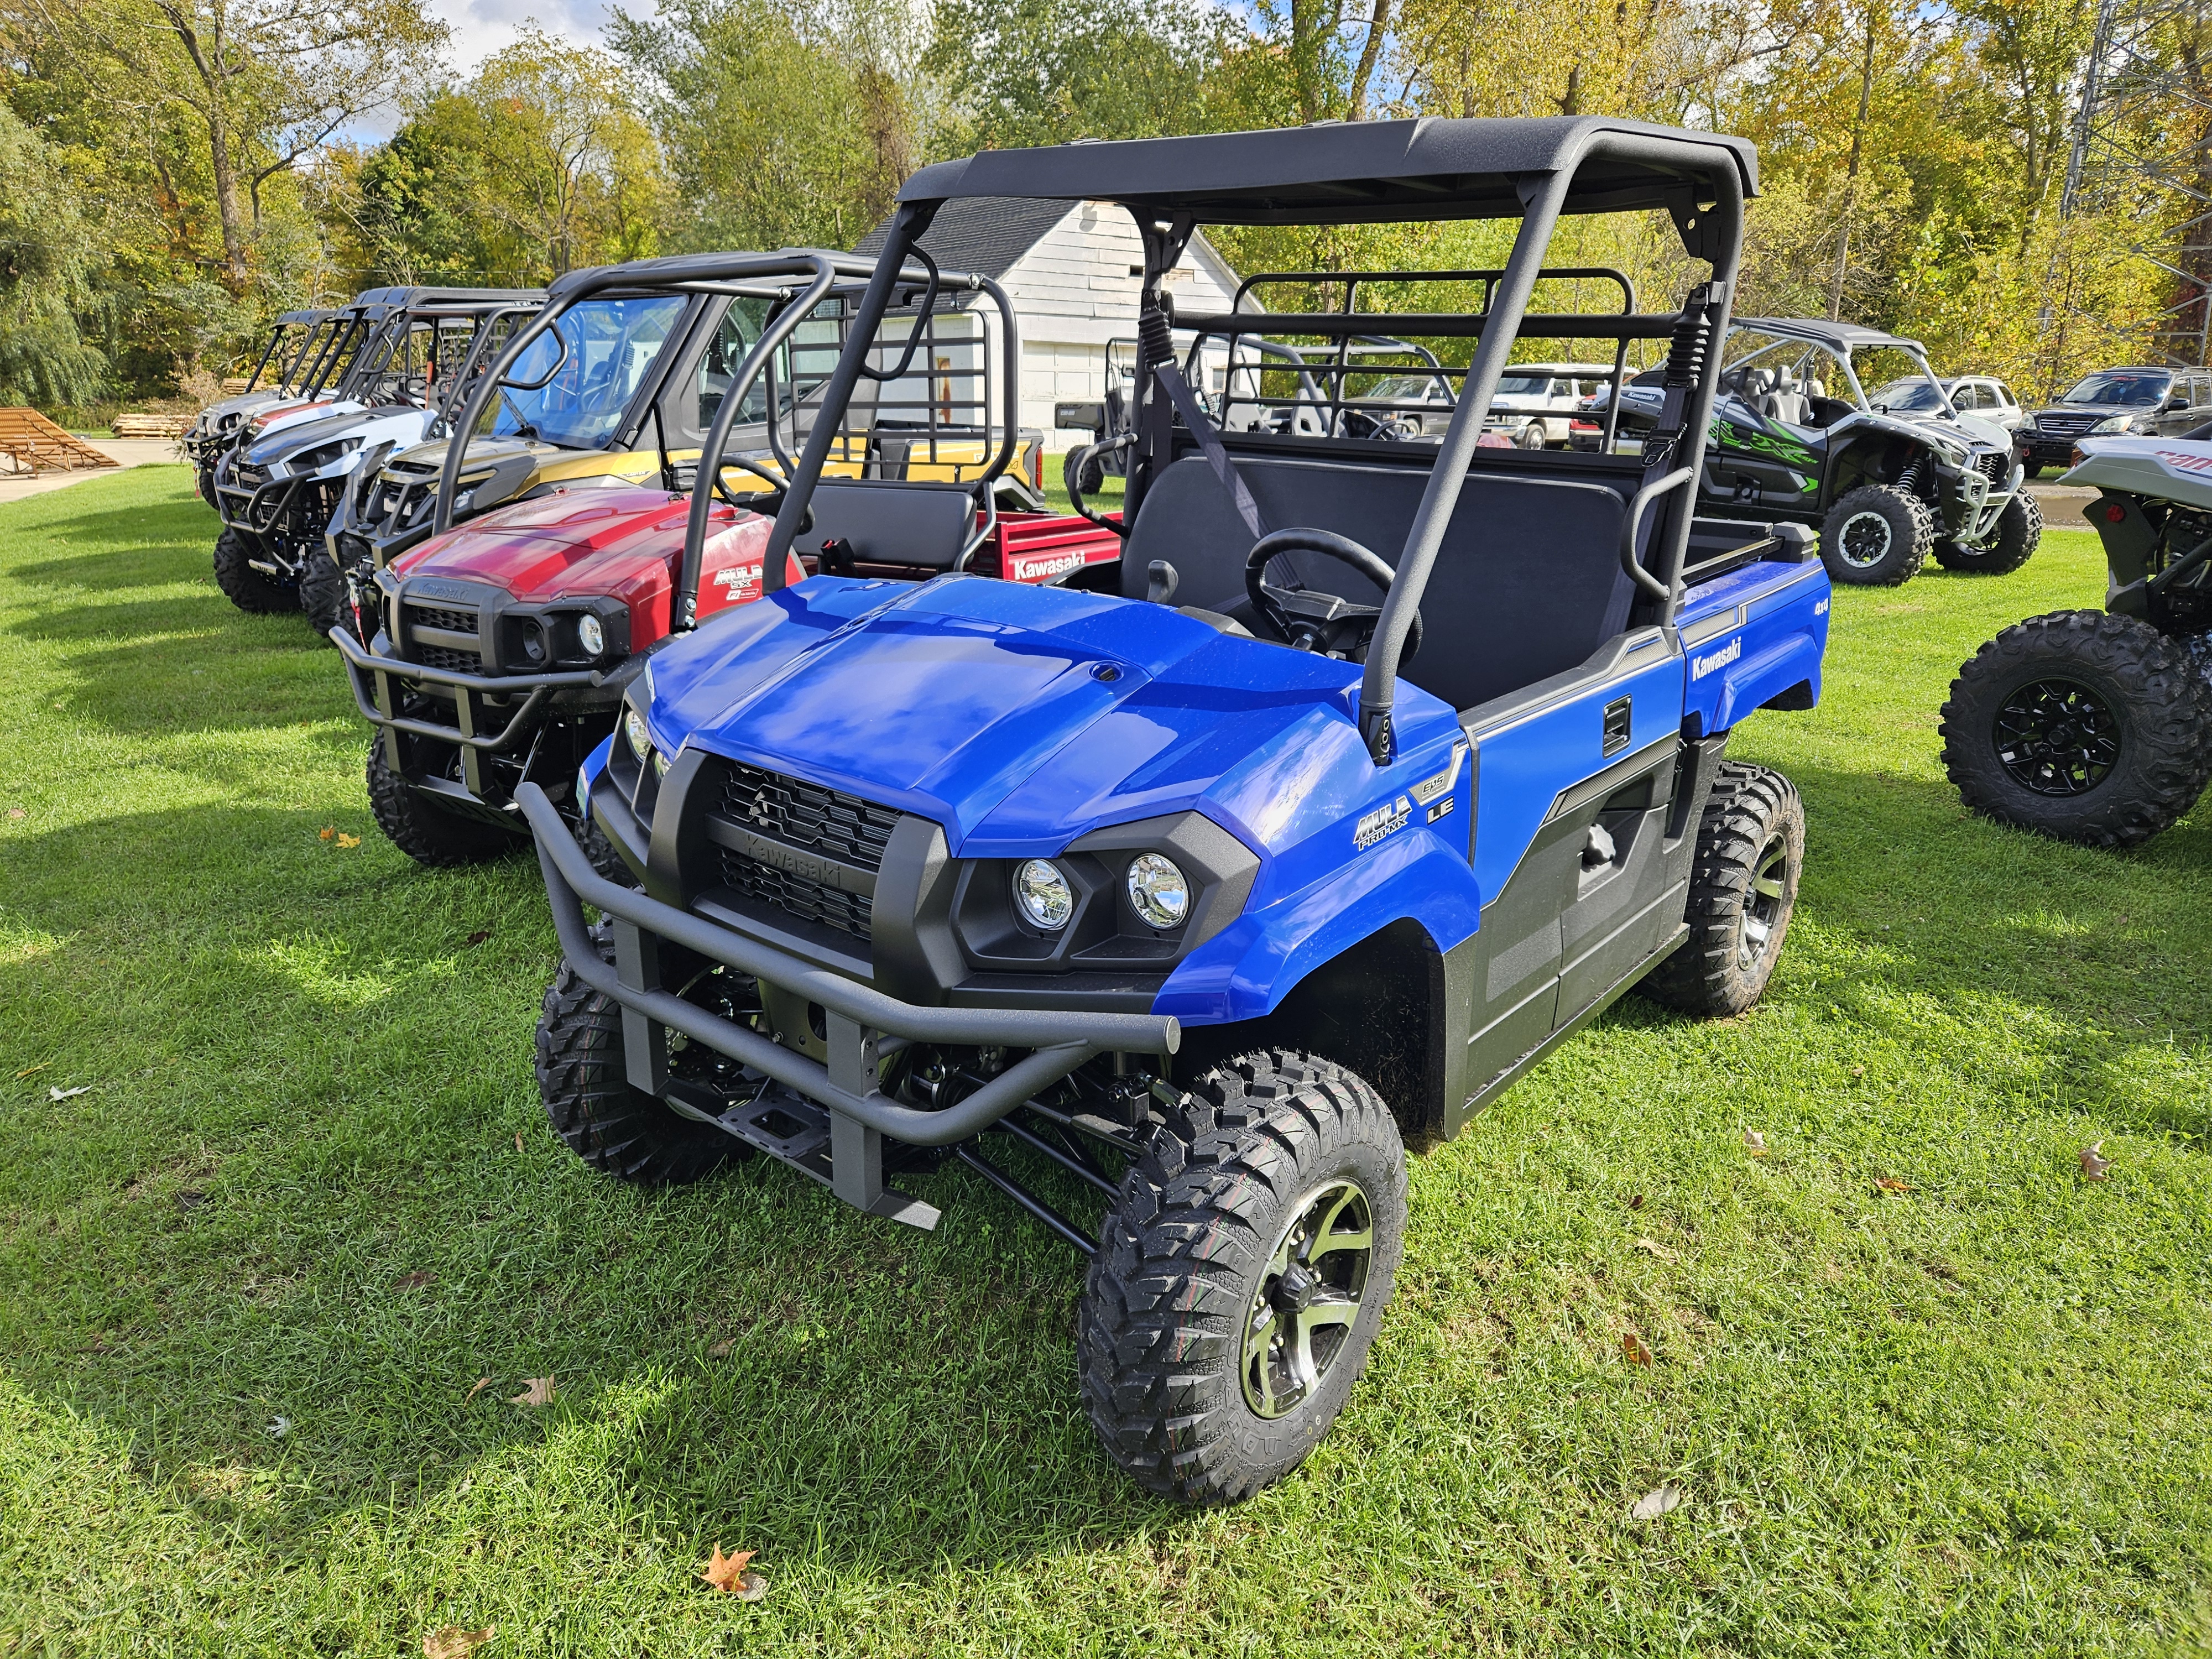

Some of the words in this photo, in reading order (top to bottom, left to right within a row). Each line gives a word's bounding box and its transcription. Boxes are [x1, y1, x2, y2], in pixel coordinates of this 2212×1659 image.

[1627, 391, 1656, 401] Kawasaki
[2154, 451, 2212, 470] can
[1014, 550, 1086, 580] Kawasaki
[417, 582, 470, 601] Kawasaki
[730, 580, 753, 589] SX
[1814, 597, 1829, 616] 4x4
[1692, 636, 1741, 682] Kawasaki
[1422, 774, 1444, 794] EPS
[1353, 795, 1413, 844] MULE
[1428, 797, 1453, 823] LE
[1359, 815, 1408, 852] PRO-MX
[748, 834, 841, 888] Kawasaki
